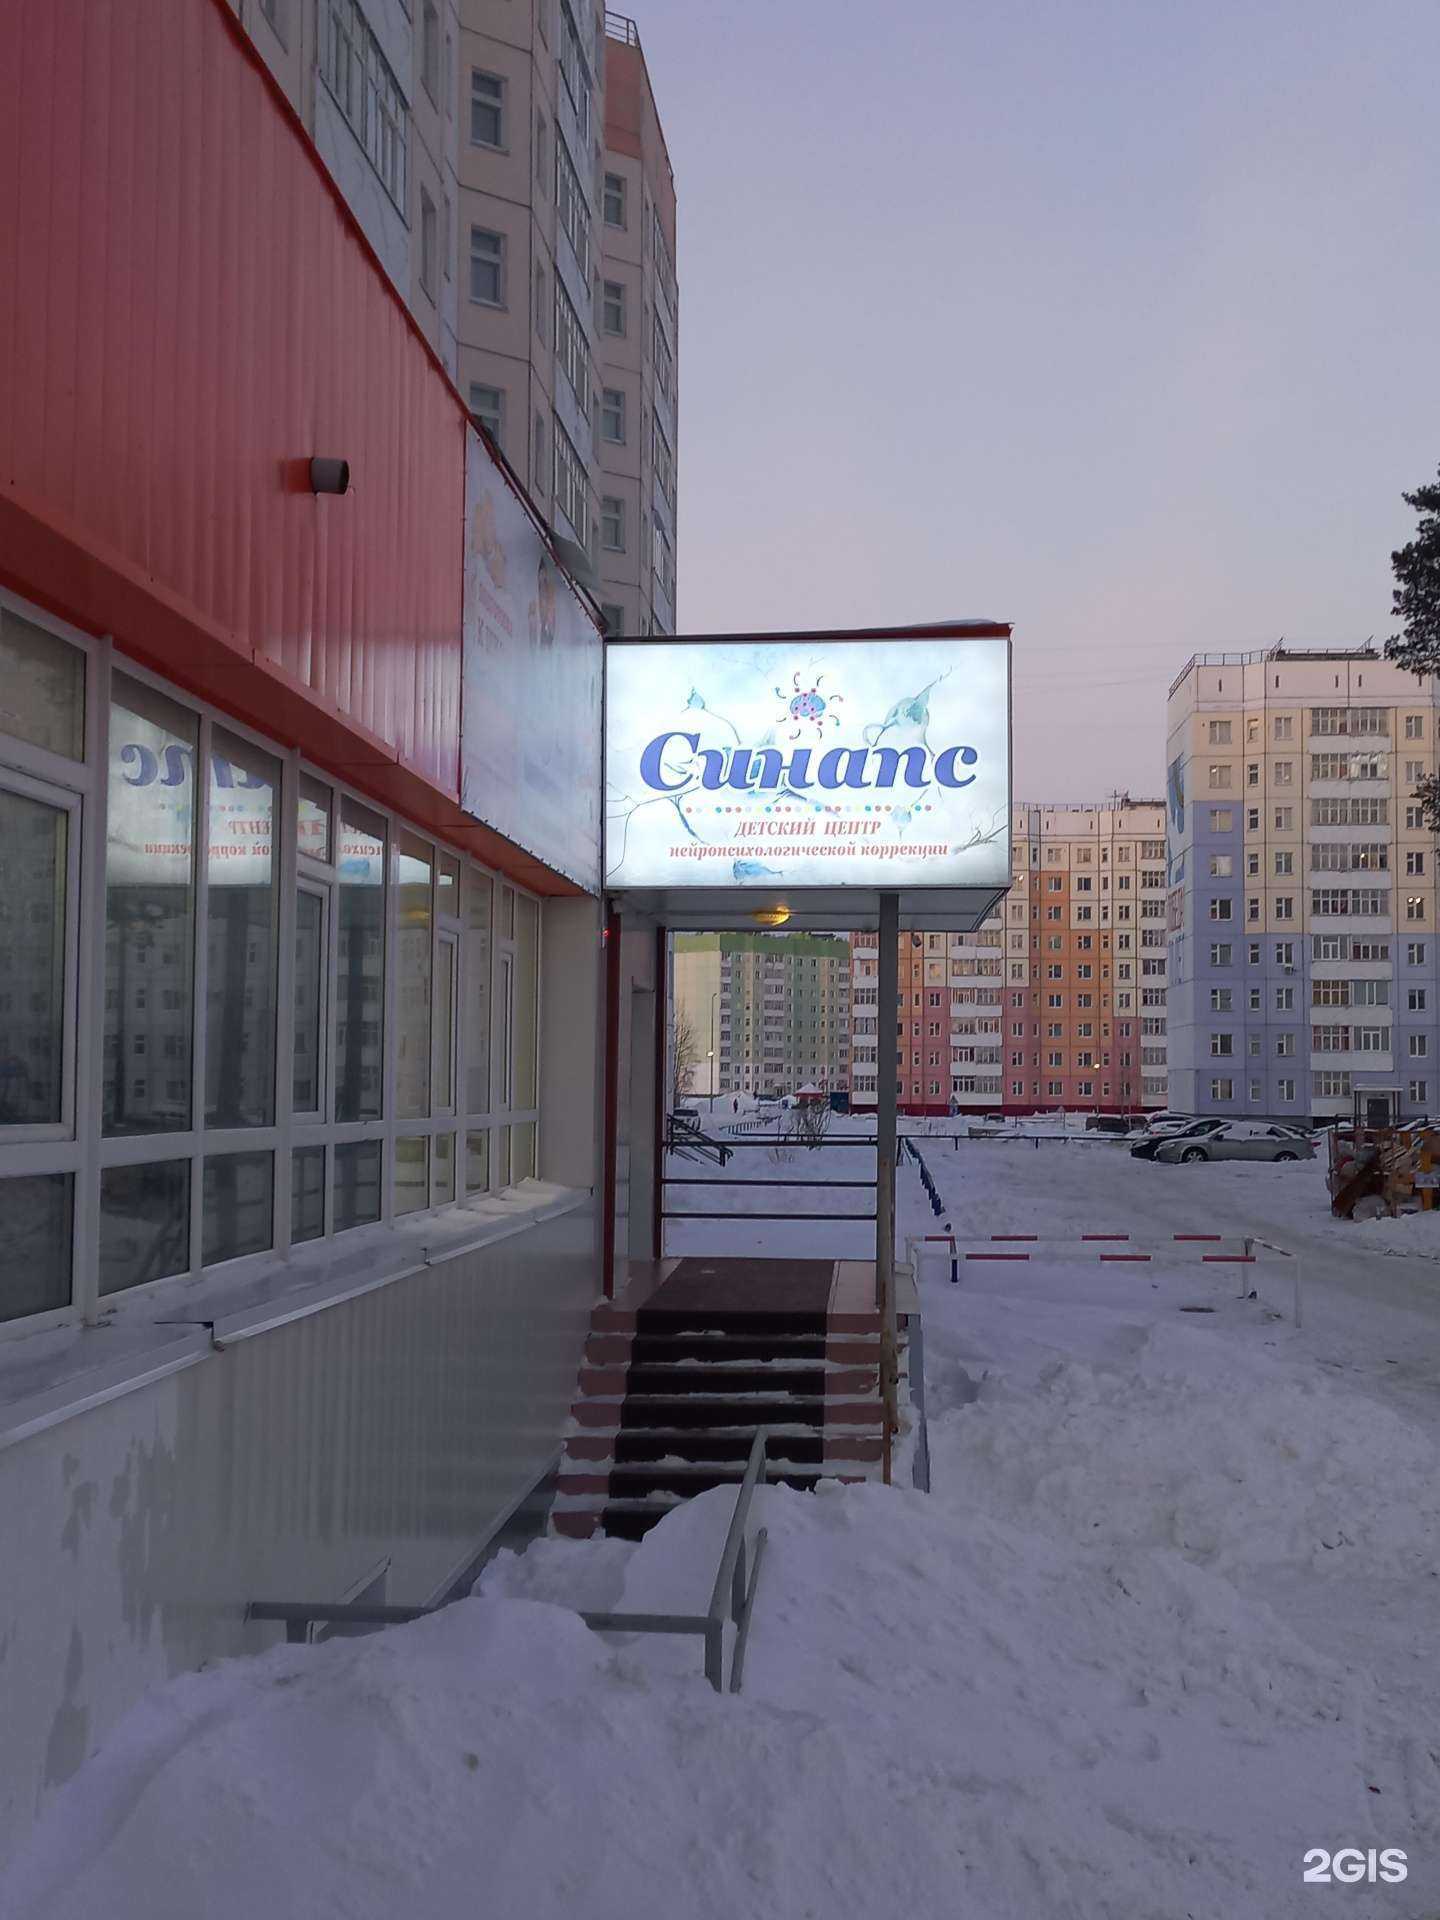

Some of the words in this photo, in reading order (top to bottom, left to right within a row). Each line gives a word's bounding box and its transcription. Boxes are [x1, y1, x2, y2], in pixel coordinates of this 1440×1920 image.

[640, 731, 978, 791] Синапс
[734, 819, 817, 838] ДЕТСКИЙ
[823, 821, 882, 838] ЦЕНТР
[669, 841, 856, 862] нейропсихологической
[860, 843, 949, 860] коррекции
